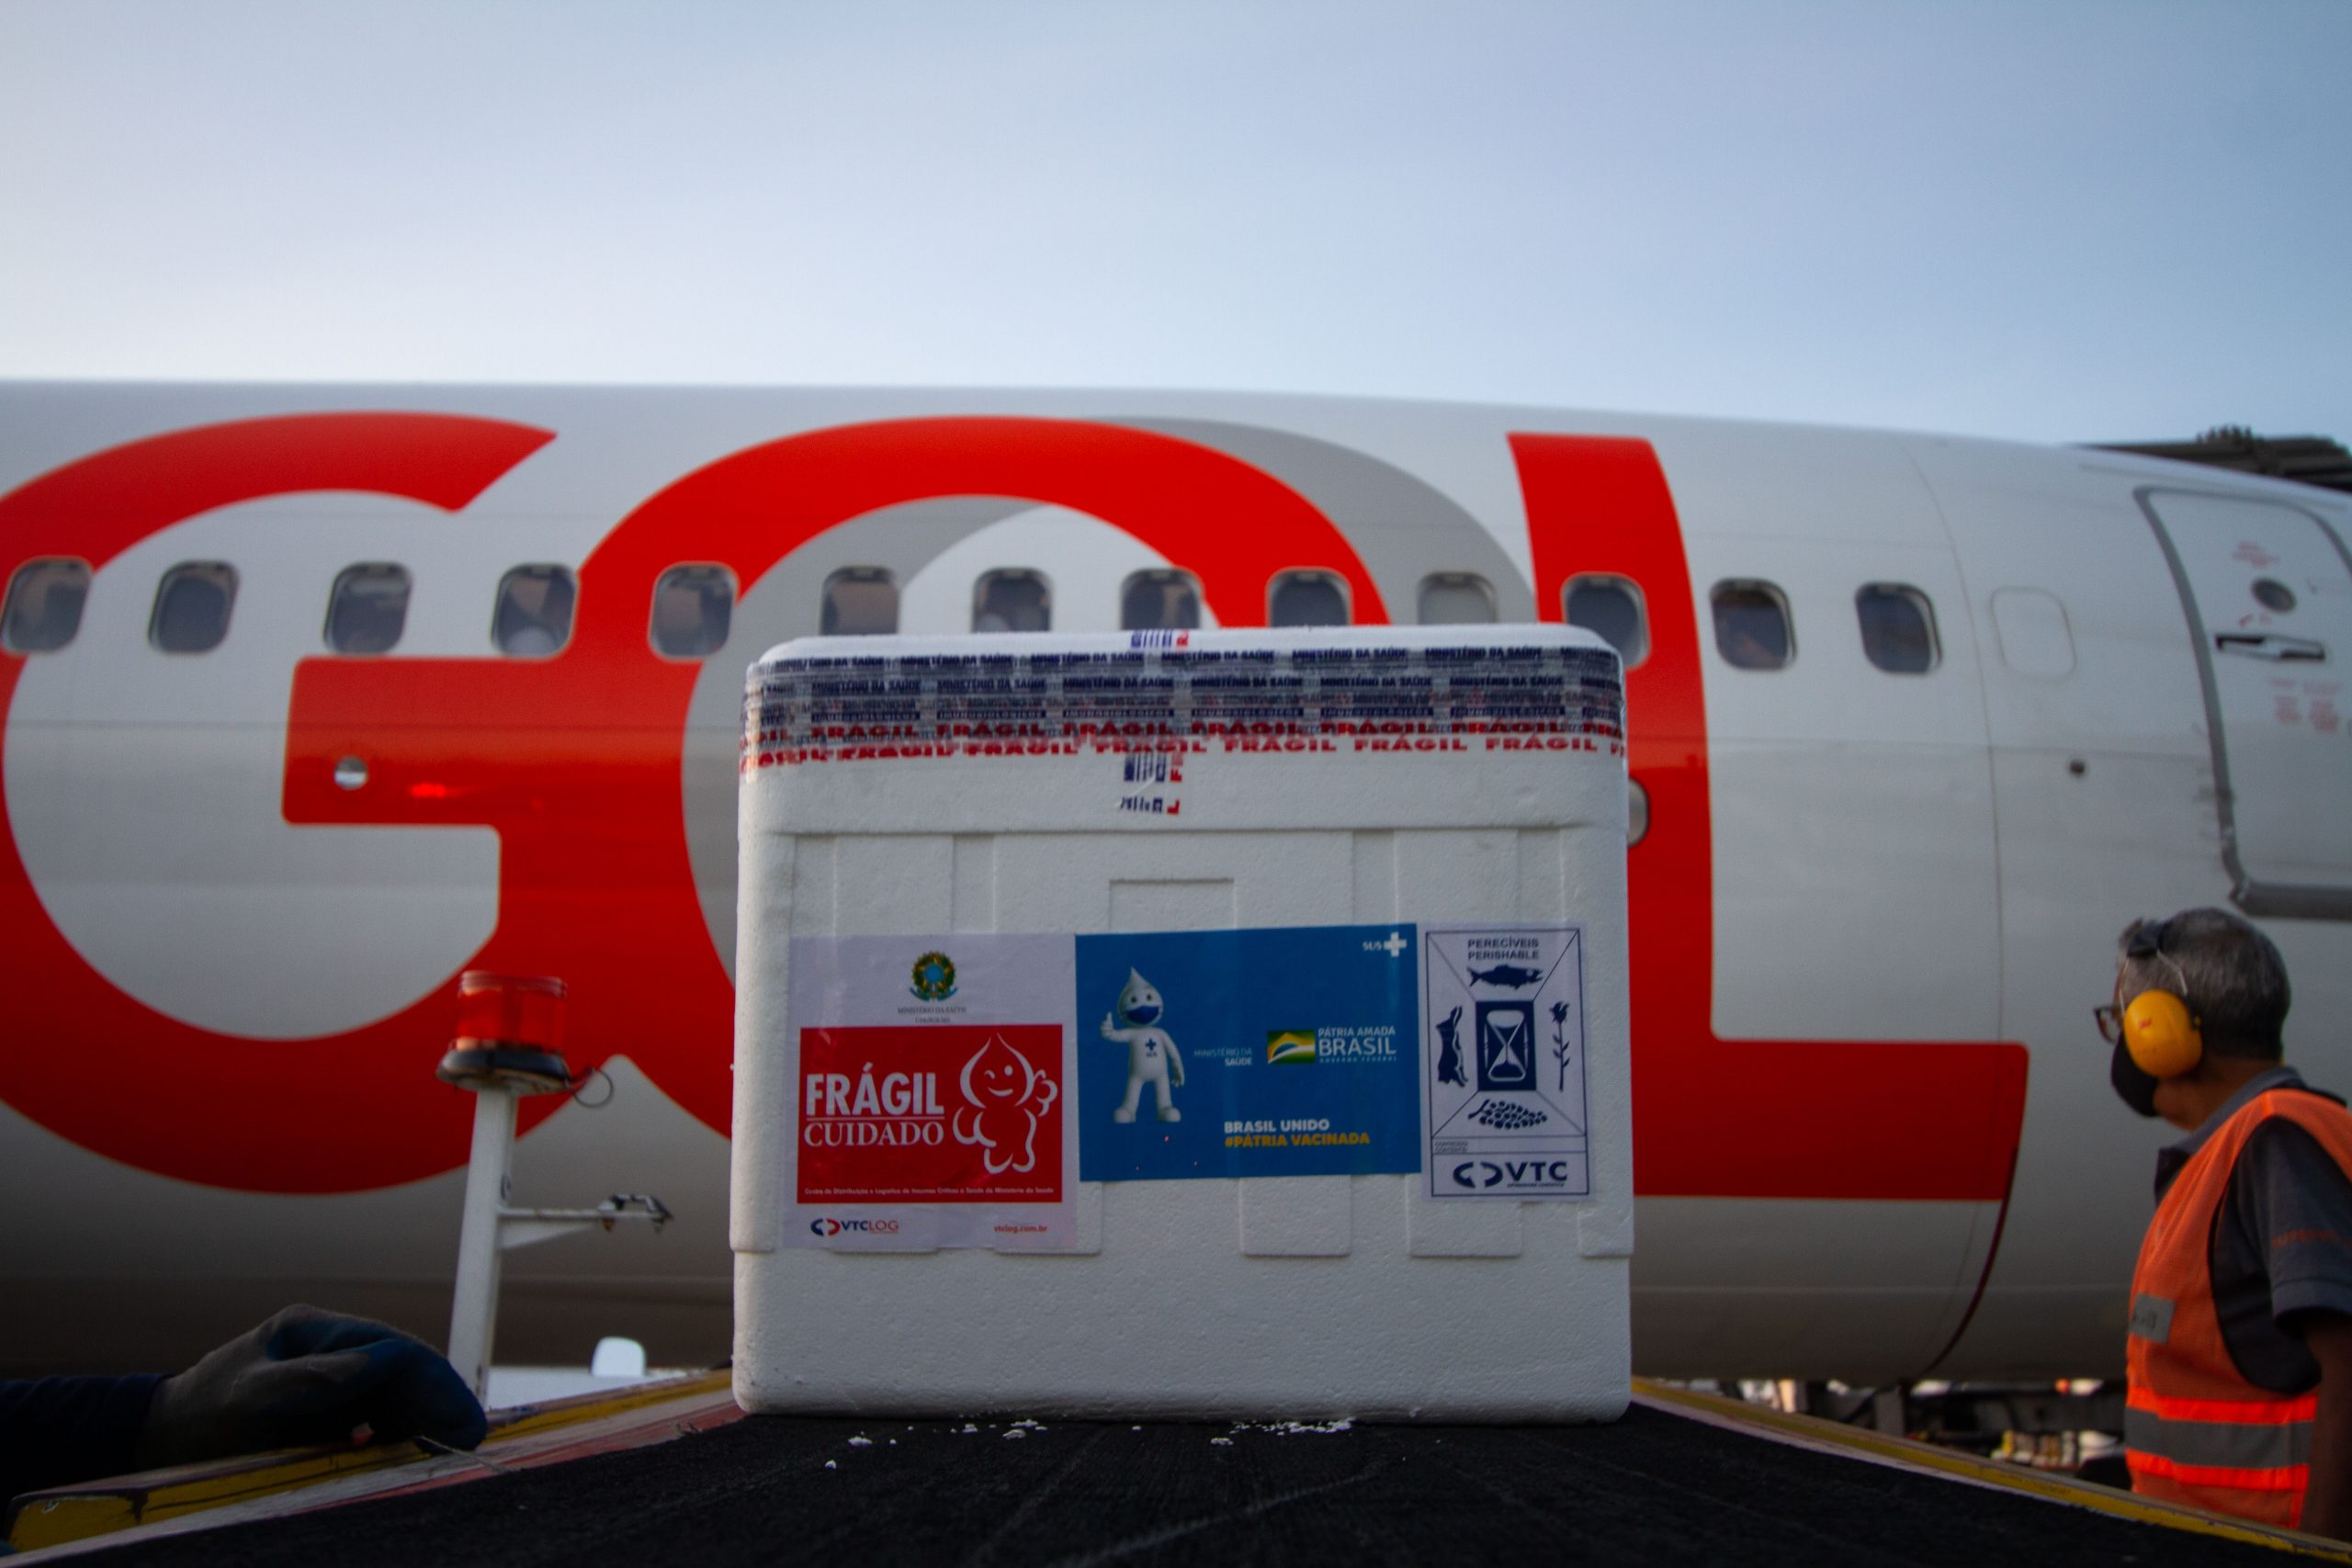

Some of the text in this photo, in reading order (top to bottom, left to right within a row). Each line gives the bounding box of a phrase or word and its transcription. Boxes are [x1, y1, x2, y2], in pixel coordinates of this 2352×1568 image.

[1320, 716, 1431, 735] FRÁGIL
[1451, 717, 1566, 735] FRÁGIL
[1354, 734, 1467, 751] FRÁGIL
[1486, 732, 1598, 751] FRÁGIL
[1467, 935, 1539, 949] PERECÍVEIS
[1467, 950, 1540, 961] PERISHABLE
[1318, 1025, 1396, 1037] PÁTRIA AMADA
[1318, 1037, 1397, 1056] BRASIL
[1225, 1056, 1253, 1066] SAÚDE
[806, 1061, 944, 1116] FRÁGIL
[804, 1121, 944, 1147] CUIDADO
[1224, 1118, 1330, 1134] BRASIL UNIDO
[1225, 1132, 1370, 1147] #PÁTRIA VACINADA
[1504, 1161, 1567, 1182] VTC
[841, 1220, 899, 1231] VTCLOG
[993, 1224, 1047, 1235] vtclog.com.br
